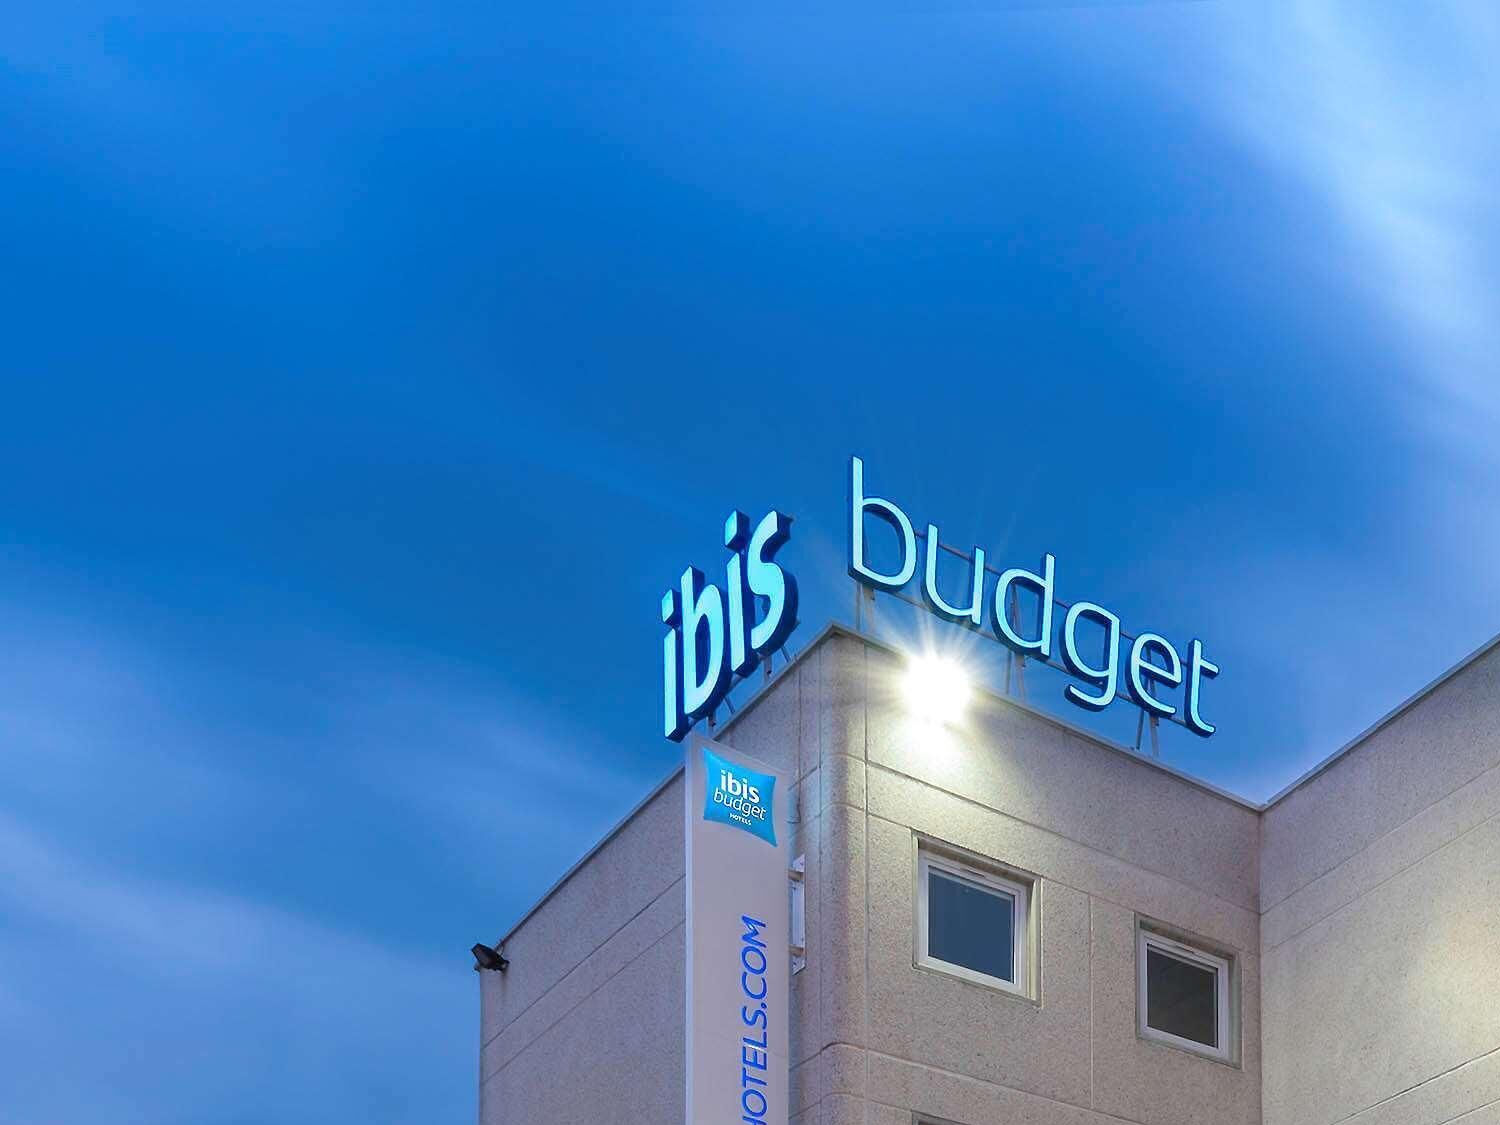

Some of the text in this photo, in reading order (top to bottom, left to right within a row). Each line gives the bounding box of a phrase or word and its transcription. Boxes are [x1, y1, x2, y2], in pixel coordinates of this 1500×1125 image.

[662, 456, 1219, 741] ibis budget
[713, 786, 767, 821] budget
[720, 768, 761, 804] ibis
[729, 812, 752, 826] HOTELS
